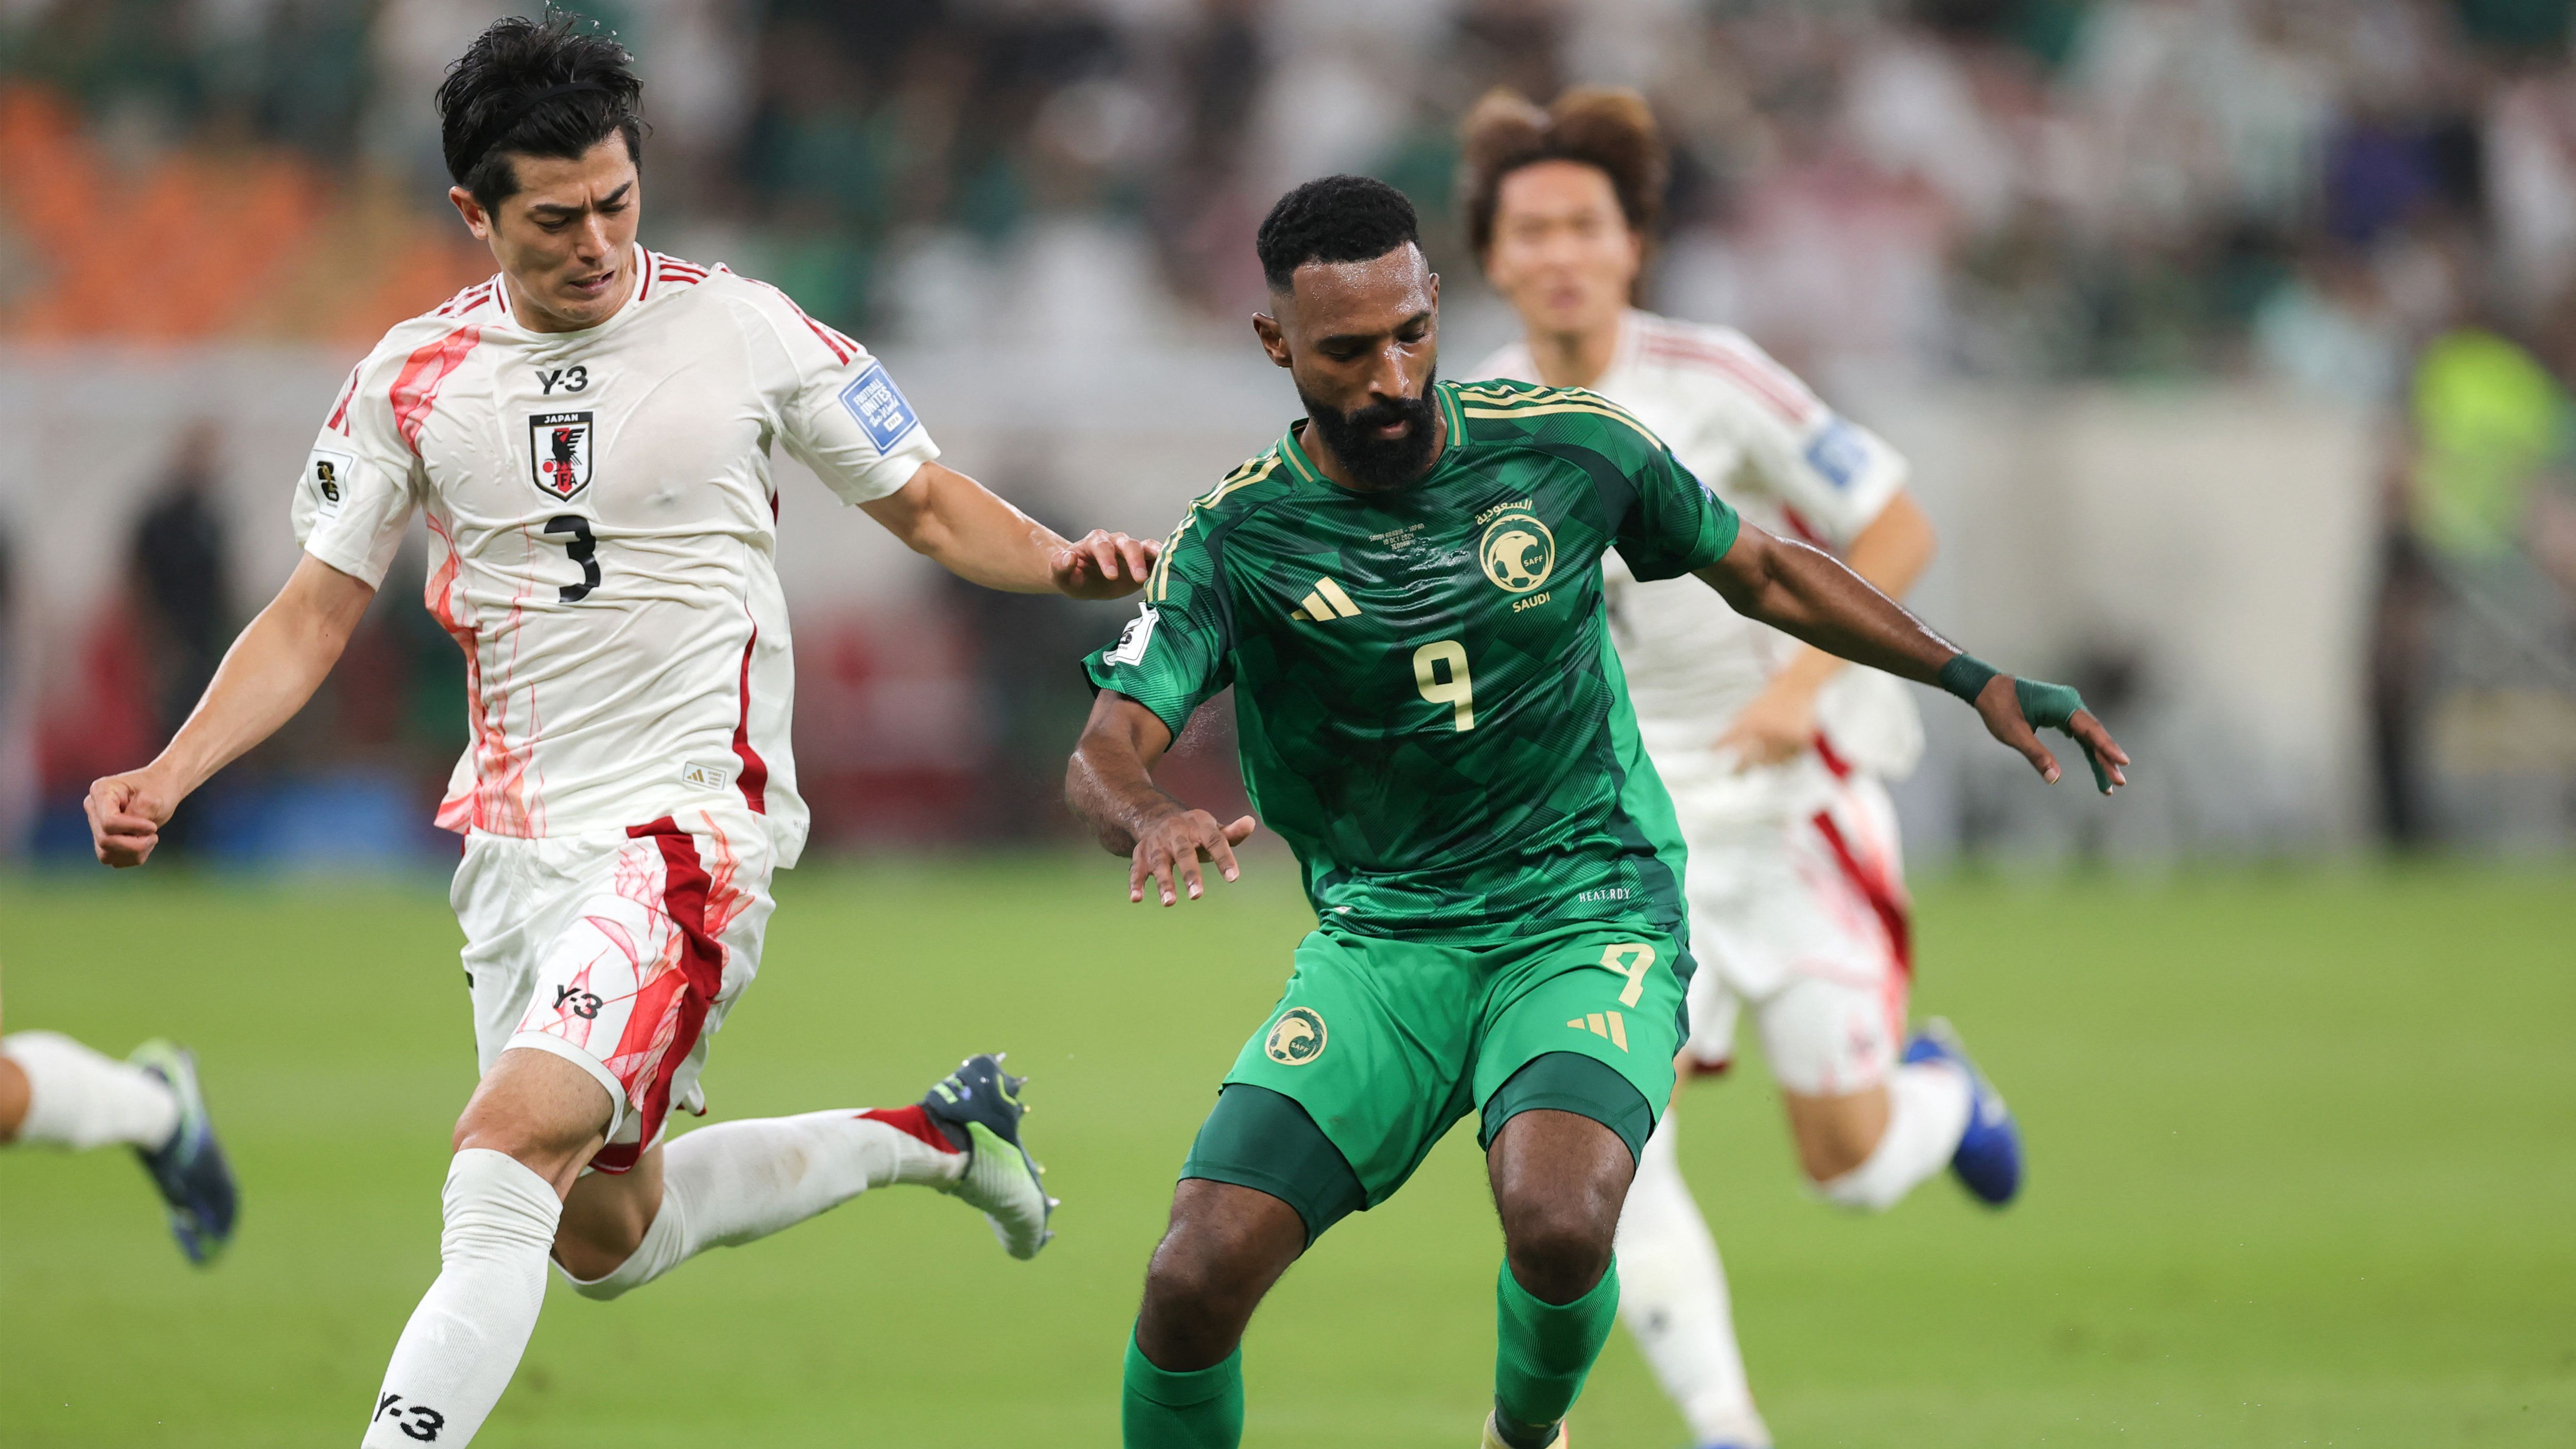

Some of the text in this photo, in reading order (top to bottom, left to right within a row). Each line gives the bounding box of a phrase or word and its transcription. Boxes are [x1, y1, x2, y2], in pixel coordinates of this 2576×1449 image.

[535, 365, 588, 395] Y-3
[852, 378, 883, 406] FOOTBALL
[860, 386, 892, 417] UNITES
[544, 413, 579, 424] JAPAN
[878, 395, 901, 419] World
[887, 416, 900, 428] FIFA
[551, 472, 578, 487] JFA
[1475, 498, 1533, 525] السعودية
[1369, 533, 1385, 542] SAUDI
[1385, 528, 1404, 538] ARABIA
[1408, 523, 1425, 532] JAPAN
[1401, 533, 1414, 541] 2024
[1391, 540, 1411, 550] JEDDAH
[544, 515, 601, 603] 3
[1524, 555, 1543, 567] SAFF
[1512, 591, 1551, 613] SAUDI
[1413, 640, 1475, 732] 9
[1579, 888, 1630, 902] HEAT.RDY
[1598, 943, 1656, 1008] 9
[553, 985, 603, 1019] Y-3
[1291, 1042, 1309, 1052] SAFF
[374, 1392, 445, 1442] Y-3
